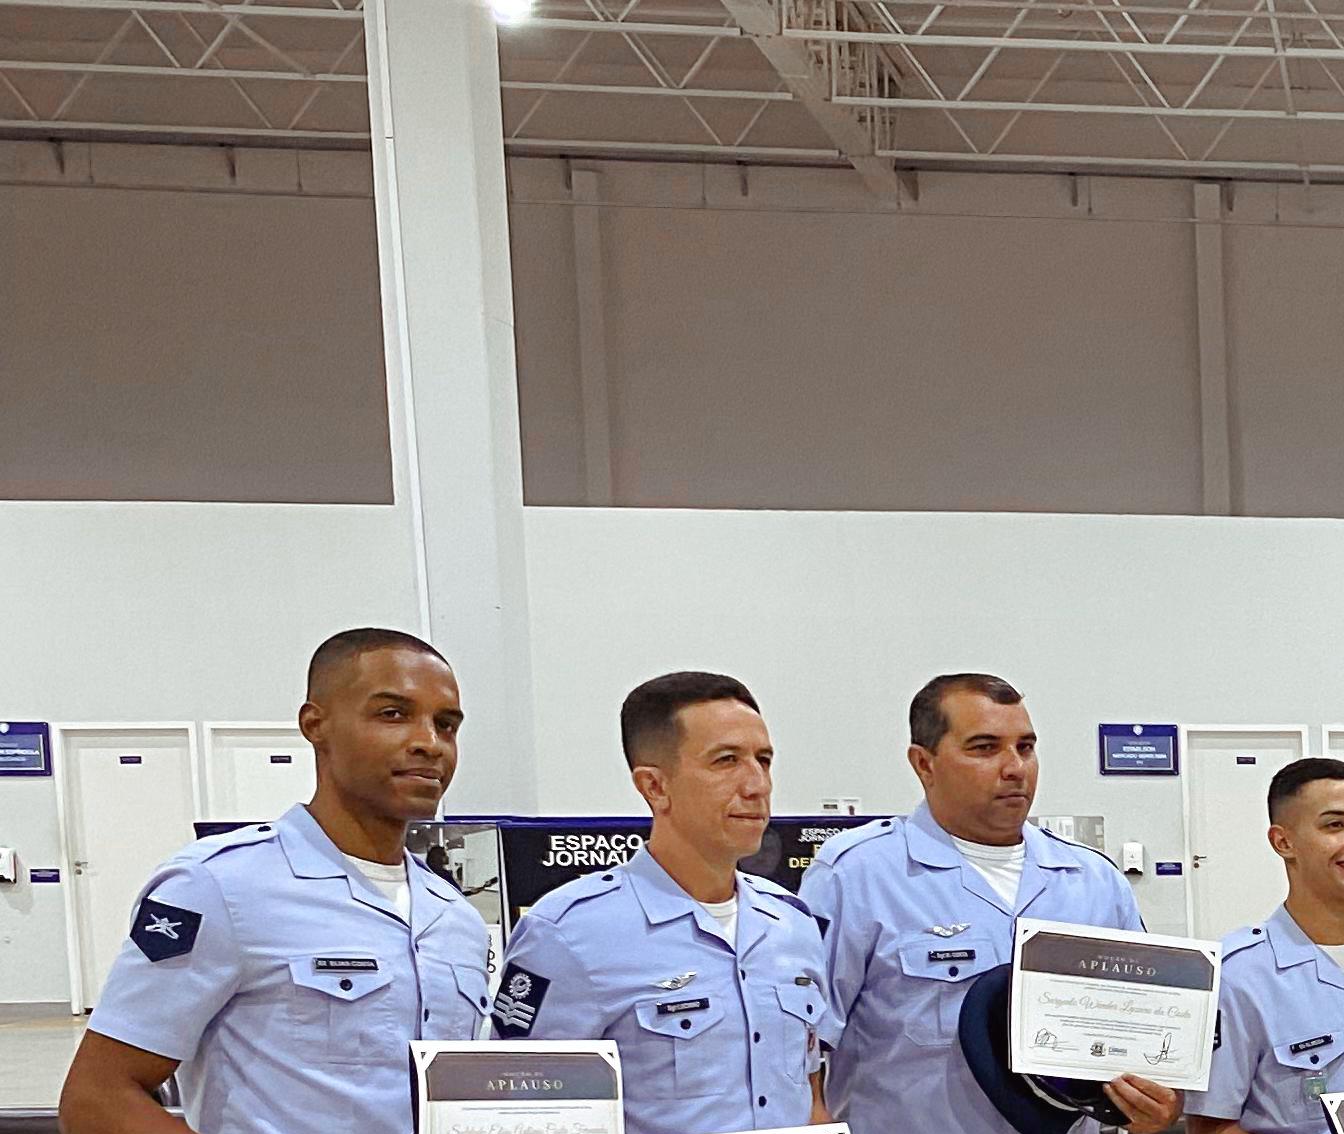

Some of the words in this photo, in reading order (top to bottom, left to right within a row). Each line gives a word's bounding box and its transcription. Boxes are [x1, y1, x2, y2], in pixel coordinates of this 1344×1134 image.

[550, 834, 644, 853] ESPAÇO
[1079, 960, 1157, 976] APLAUSO
[487, 1079, 564, 1091] APLAUSO
